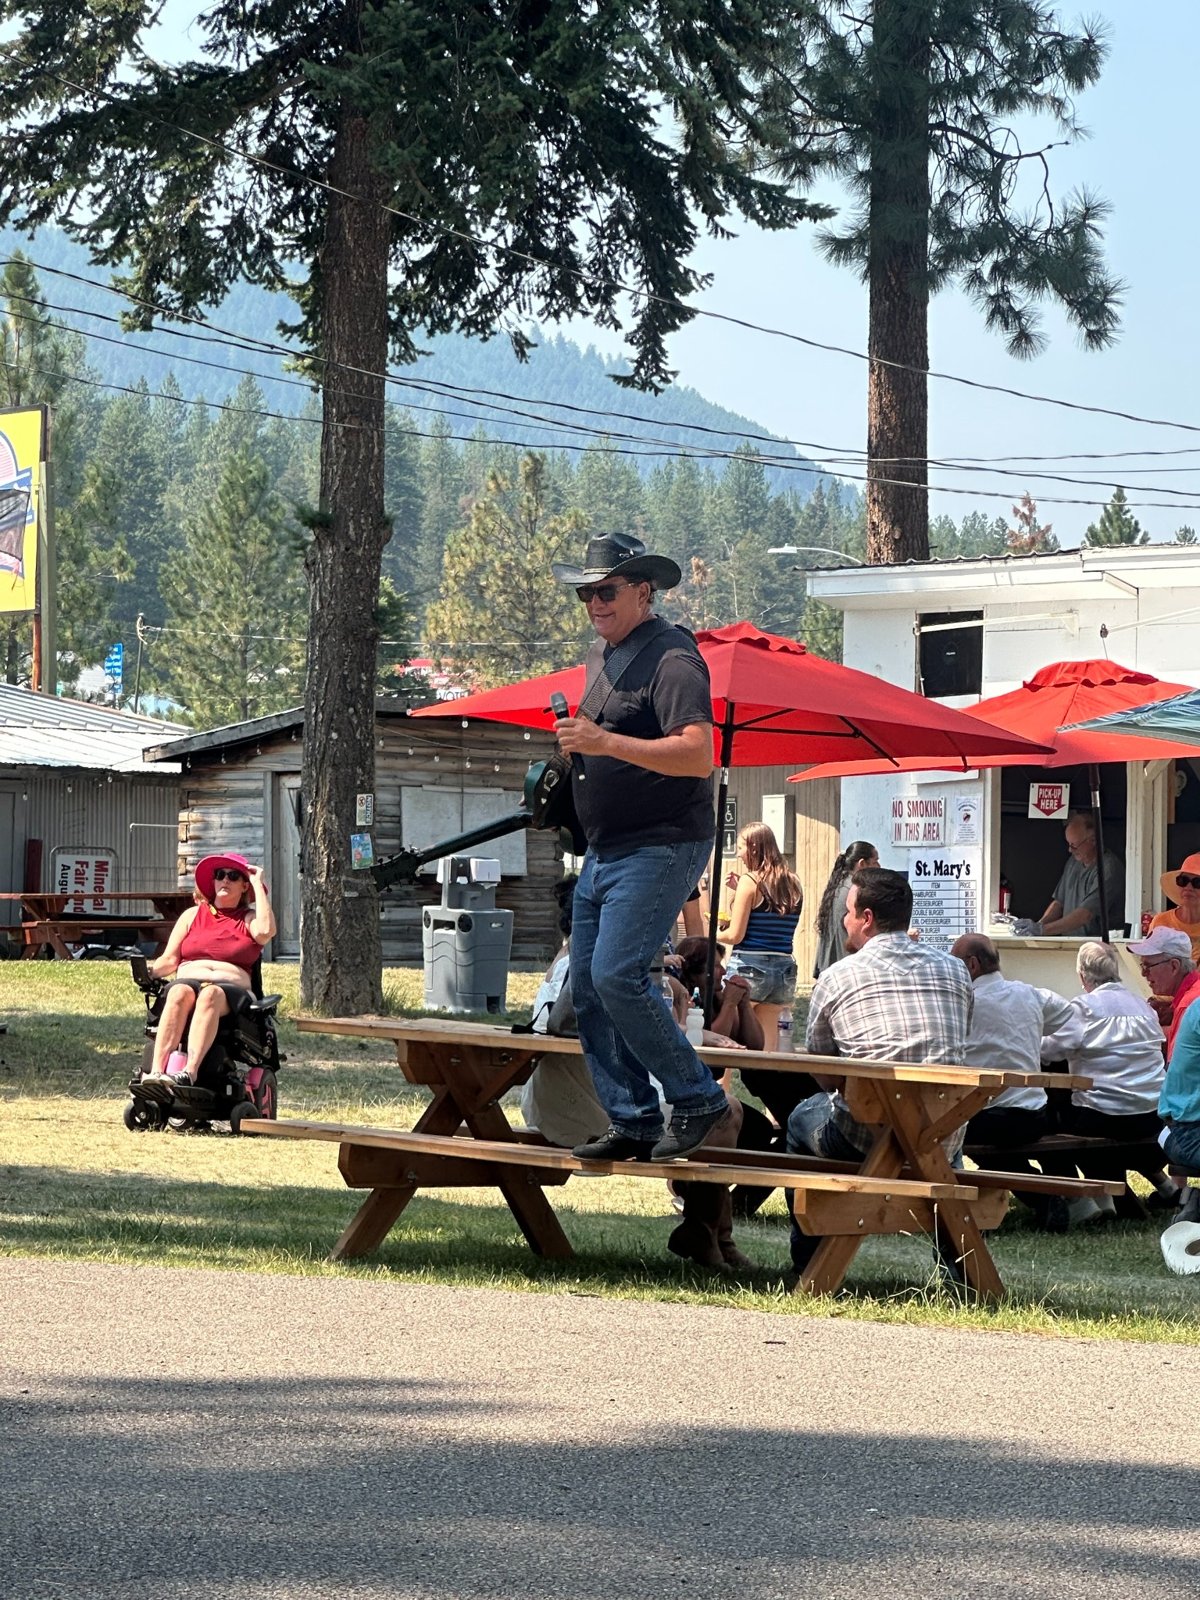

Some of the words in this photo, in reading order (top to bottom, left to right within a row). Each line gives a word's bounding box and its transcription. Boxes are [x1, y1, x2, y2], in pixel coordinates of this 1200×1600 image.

[1038, 788, 1062, 799] PICK-UP
[892, 800, 904, 818] NO
[907, 800, 943, 818] SMOKING
[1040, 799, 1058, 810] HERE
[894, 822, 902, 841] IN
[905, 822, 920, 841] THIS
[922, 822, 940, 841] AREA
[74, 860, 89, 886] Fair
[915, 860, 931, 876] St.
[934, 860, 971, 880] Mary's
[92, 860, 109, 911] Mineal
